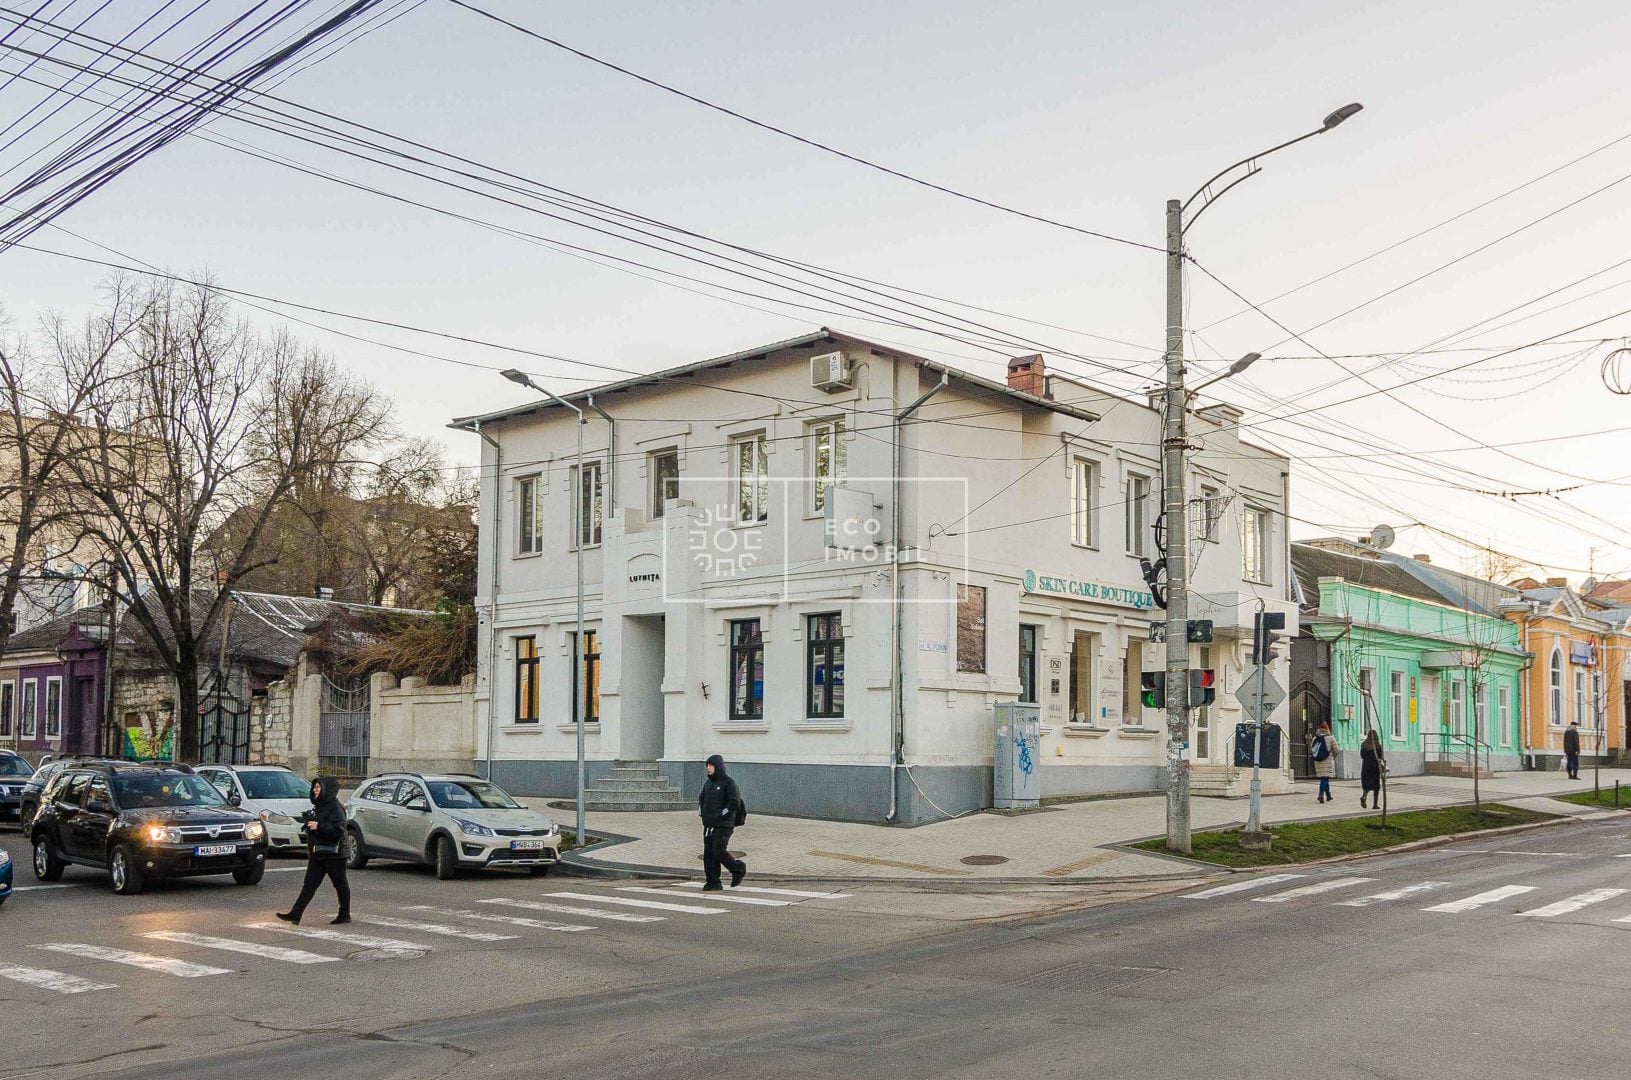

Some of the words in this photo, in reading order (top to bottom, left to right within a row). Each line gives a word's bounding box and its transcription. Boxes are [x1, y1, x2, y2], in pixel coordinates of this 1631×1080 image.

[1039, 576, 1067, 593] SKIN
[1069, 580, 1099, 598] CARE
[1101, 586, 1153, 608] BOUTIQUE
